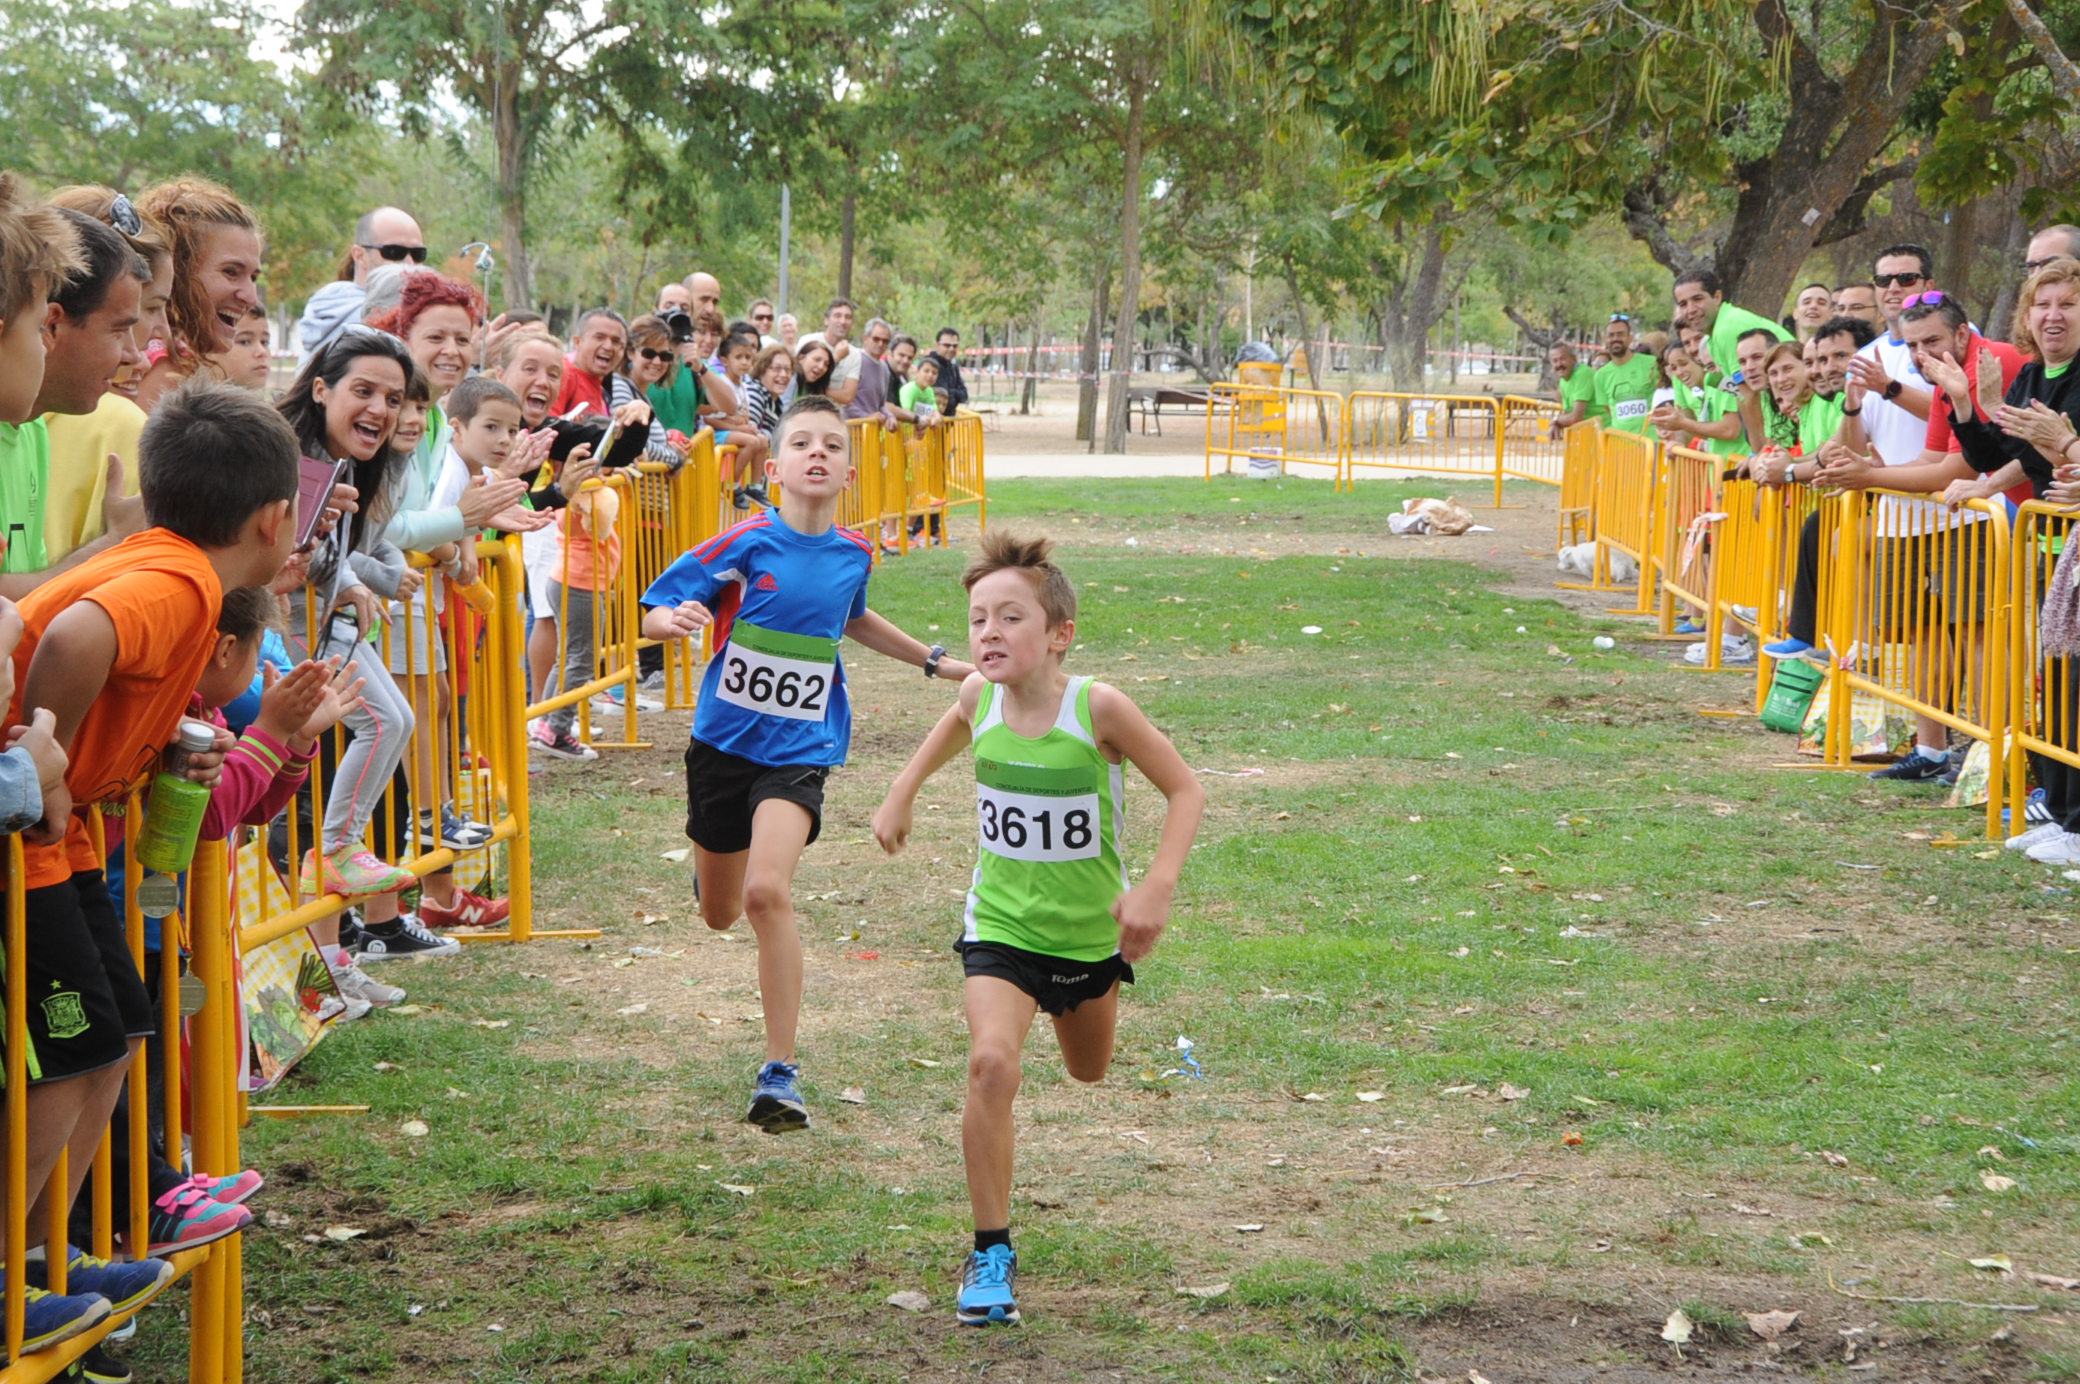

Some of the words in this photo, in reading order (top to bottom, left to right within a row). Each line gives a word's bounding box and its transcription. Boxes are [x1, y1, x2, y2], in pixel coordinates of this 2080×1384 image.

[1618, 403, 1646, 417] 3060
[724, 657, 825, 711] 3662
[981, 799, 1093, 851] 3618
